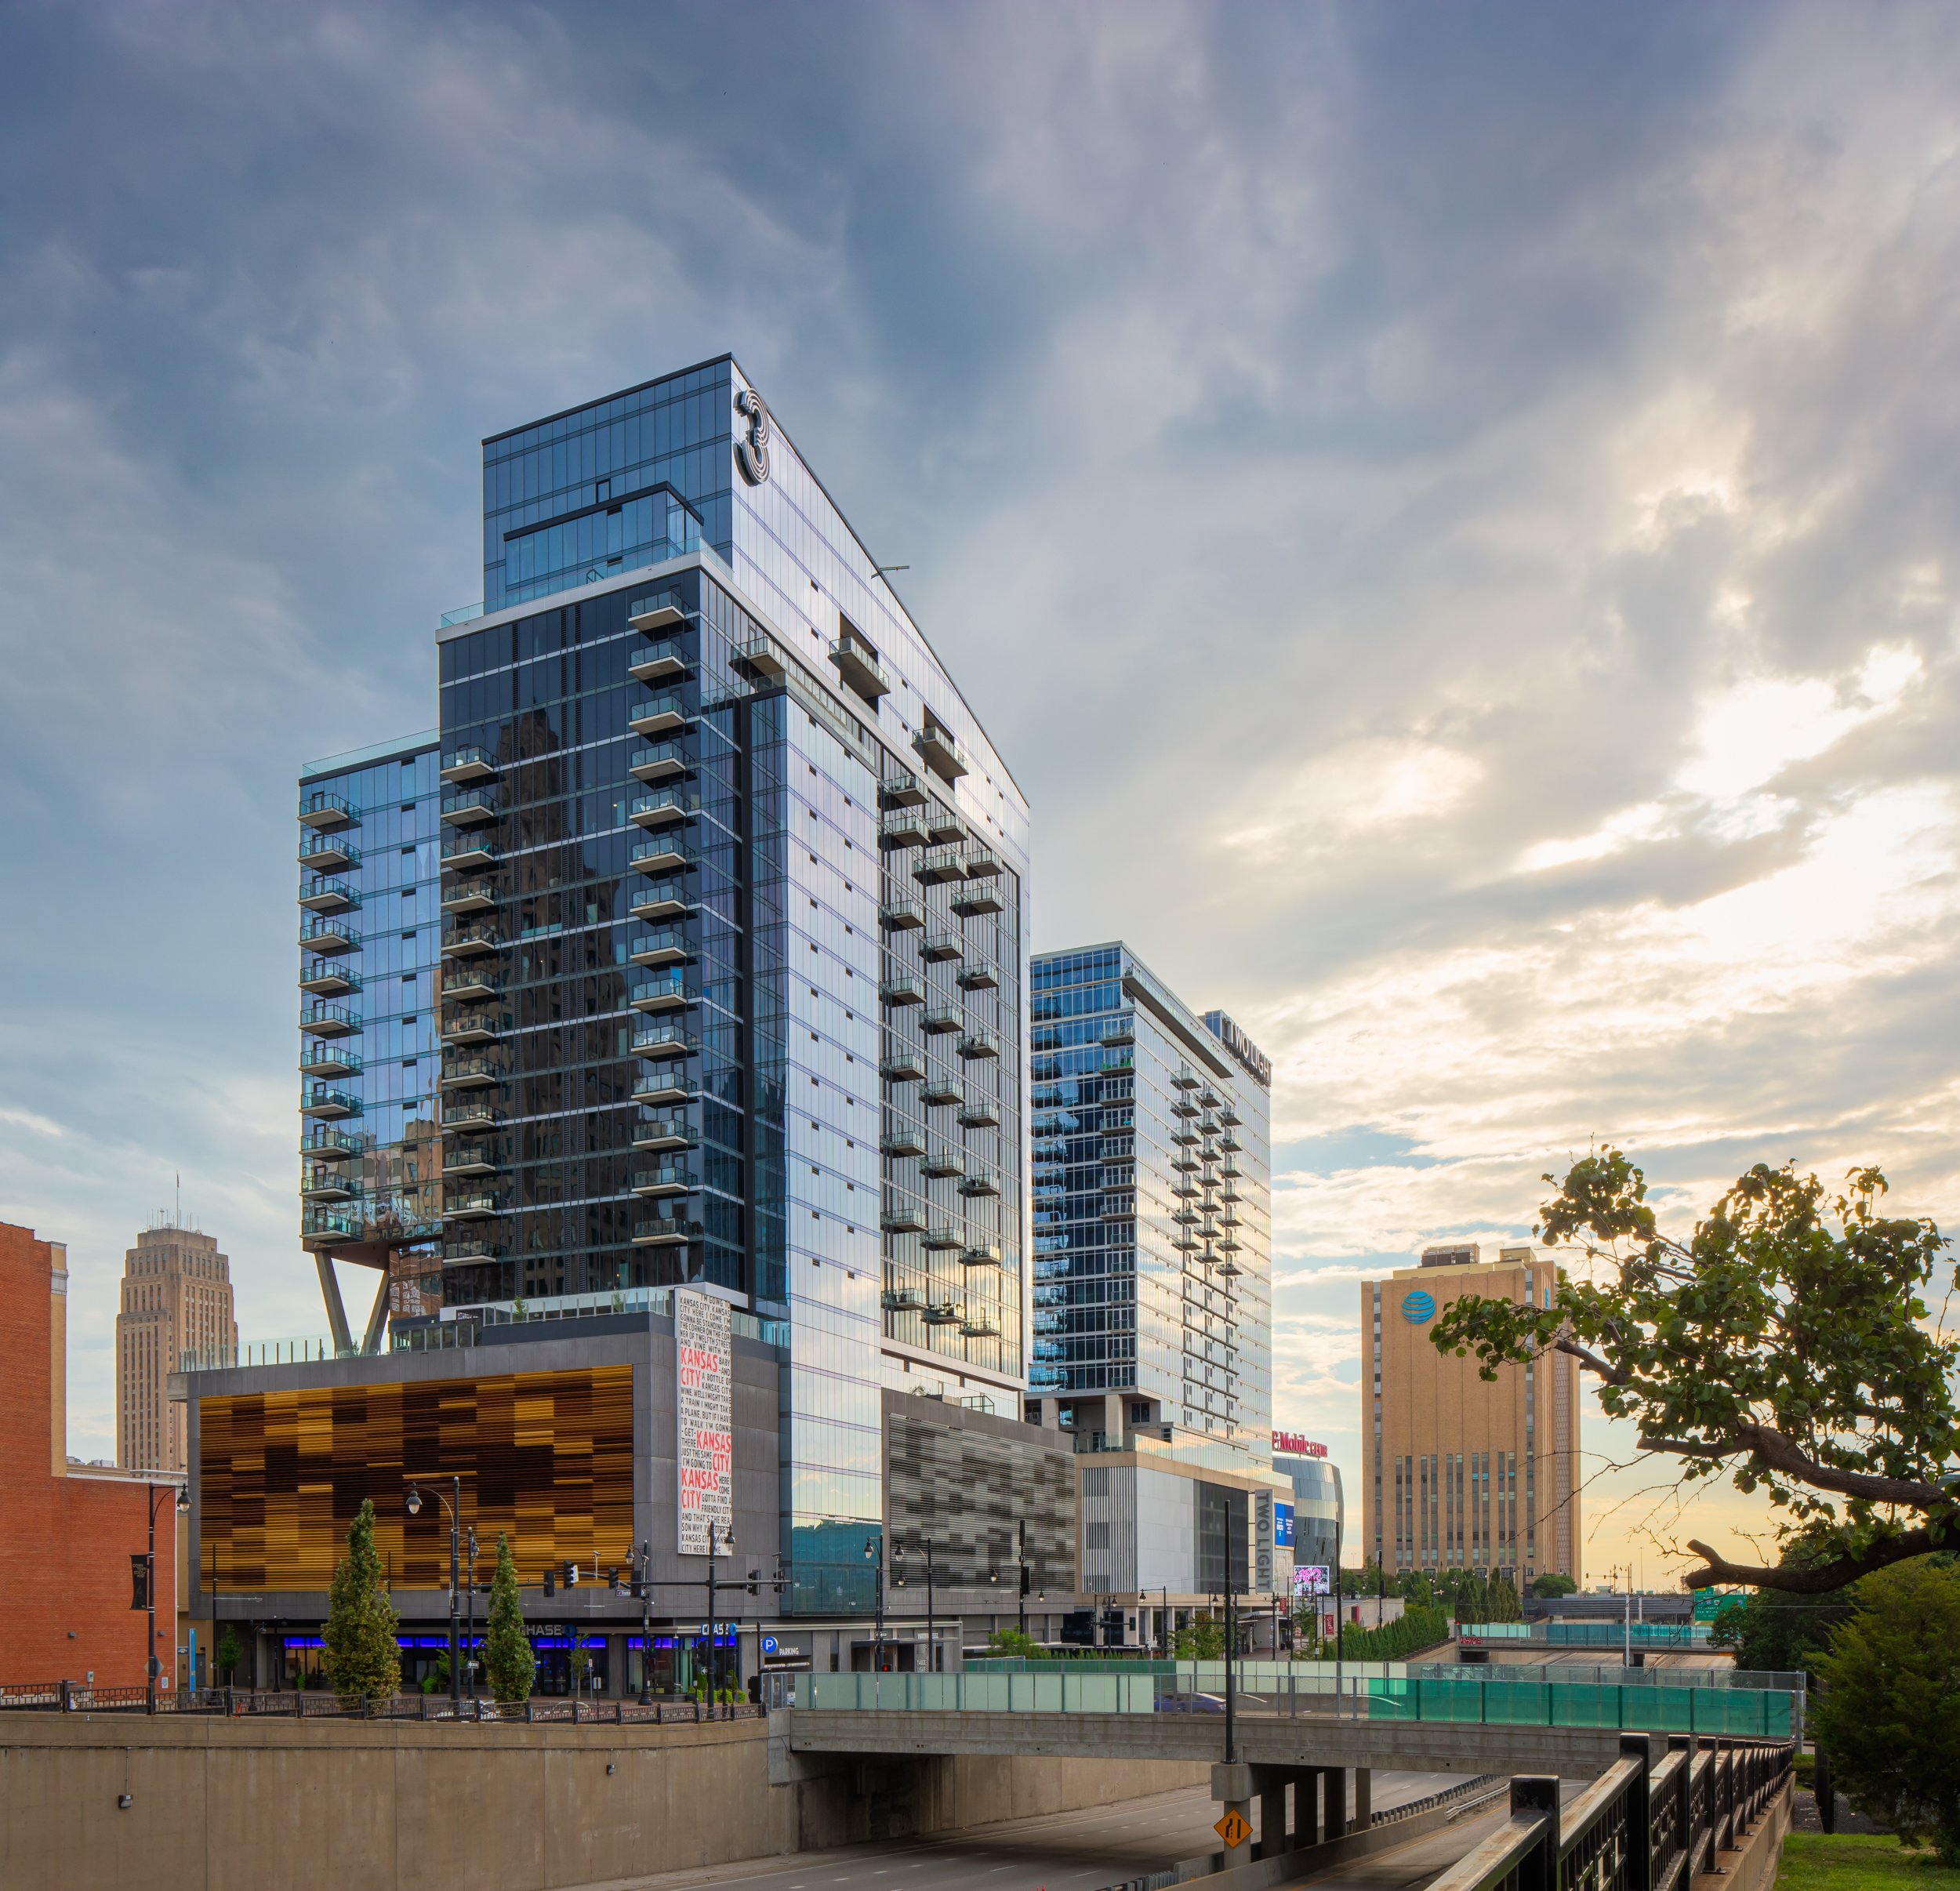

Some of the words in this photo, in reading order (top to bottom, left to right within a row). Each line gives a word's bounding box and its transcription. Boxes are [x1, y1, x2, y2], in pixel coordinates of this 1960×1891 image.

[733, 388, 770, 487] 3
[1227, 1017, 1250, 1058] TWO
[1250, 1041, 1273, 1085] LIGHT
[681, 1297, 699, 1308] KANSAS
[712, 1305, 731, 1317] KANSAS
[709, 1296, 724, 1307] GOING
[681, 1305, 690, 1314] CITY
[692, 1308, 704, 1318] HERE
[710, 1313, 722, 1323] COME
[681, 1313, 695, 1323] GONNA
[697, 1317, 702, 1326] BE
[702, 1319, 724, 1331] STANDING
[689, 1323, 705, 1334] CORNER
[681, 1338, 691, 1347] AND
[694, 1341, 706, 1351] VINE
[709, 1345, 720, 1354] WITH
[695, 1333, 715, 1345] TWELFTH
[716, 1338, 731, 1348] STREET
[681, 1346, 717, 1373] KANSAS
[719, 1357, 730, 1367] BABY
[681, 1367, 700, 1388] CITY
[707, 1374, 724, 1384] BOTTLE
[702, 1382, 720, 1393] KANSAS
[694, 1389, 705, 1399] WELL
[708, 1392, 720, 1402] MIGHT
[721, 1396, 731, 1404] TAKE
[686, 1398, 700, 1406] TRAIN
[705, 1401, 718, 1411] MIGHT
[720, 1405, 731, 1414] TAKE
[690, 1419, 703, 1428] WALK
[702, 1411, 711, 1420] BUT
[720, 1414, 731, 1423] HAVE
[681, 1438, 696, 1448] THERE
[696, 1430, 731, 1454] KANSAS
[681, 1448, 691, 1457] JUST
[701, 1450, 712, 1460] SAME
[691, 1459, 705, 1469] GOING
[706, 1461, 712, 1470] TO
[681, 1468, 718, 1491] KANSAS
[719, 1476, 729, 1485] HERE
[681, 1489, 701, 1510] CITY
[702, 1494, 716, 1503] GOTTA
[717, 1496, 727, 1504] FIND
[702, 1504, 721, 1514] FRIENDLY
[1257, 1493, 1269, 1532] TWO
[682, 1512, 691, 1522] AND
[711, 1515, 720, 1524] THE
[682, 1523, 691, 1531] SON
[682, 1534, 702, 1543] KANSAS
[1258, 1539, 1269, 1588] LIGHT
[518, 1624, 563, 1635] CHASE
[765, 1639, 774, 1650] P
[779, 1647, 799, 1656] PARKING
